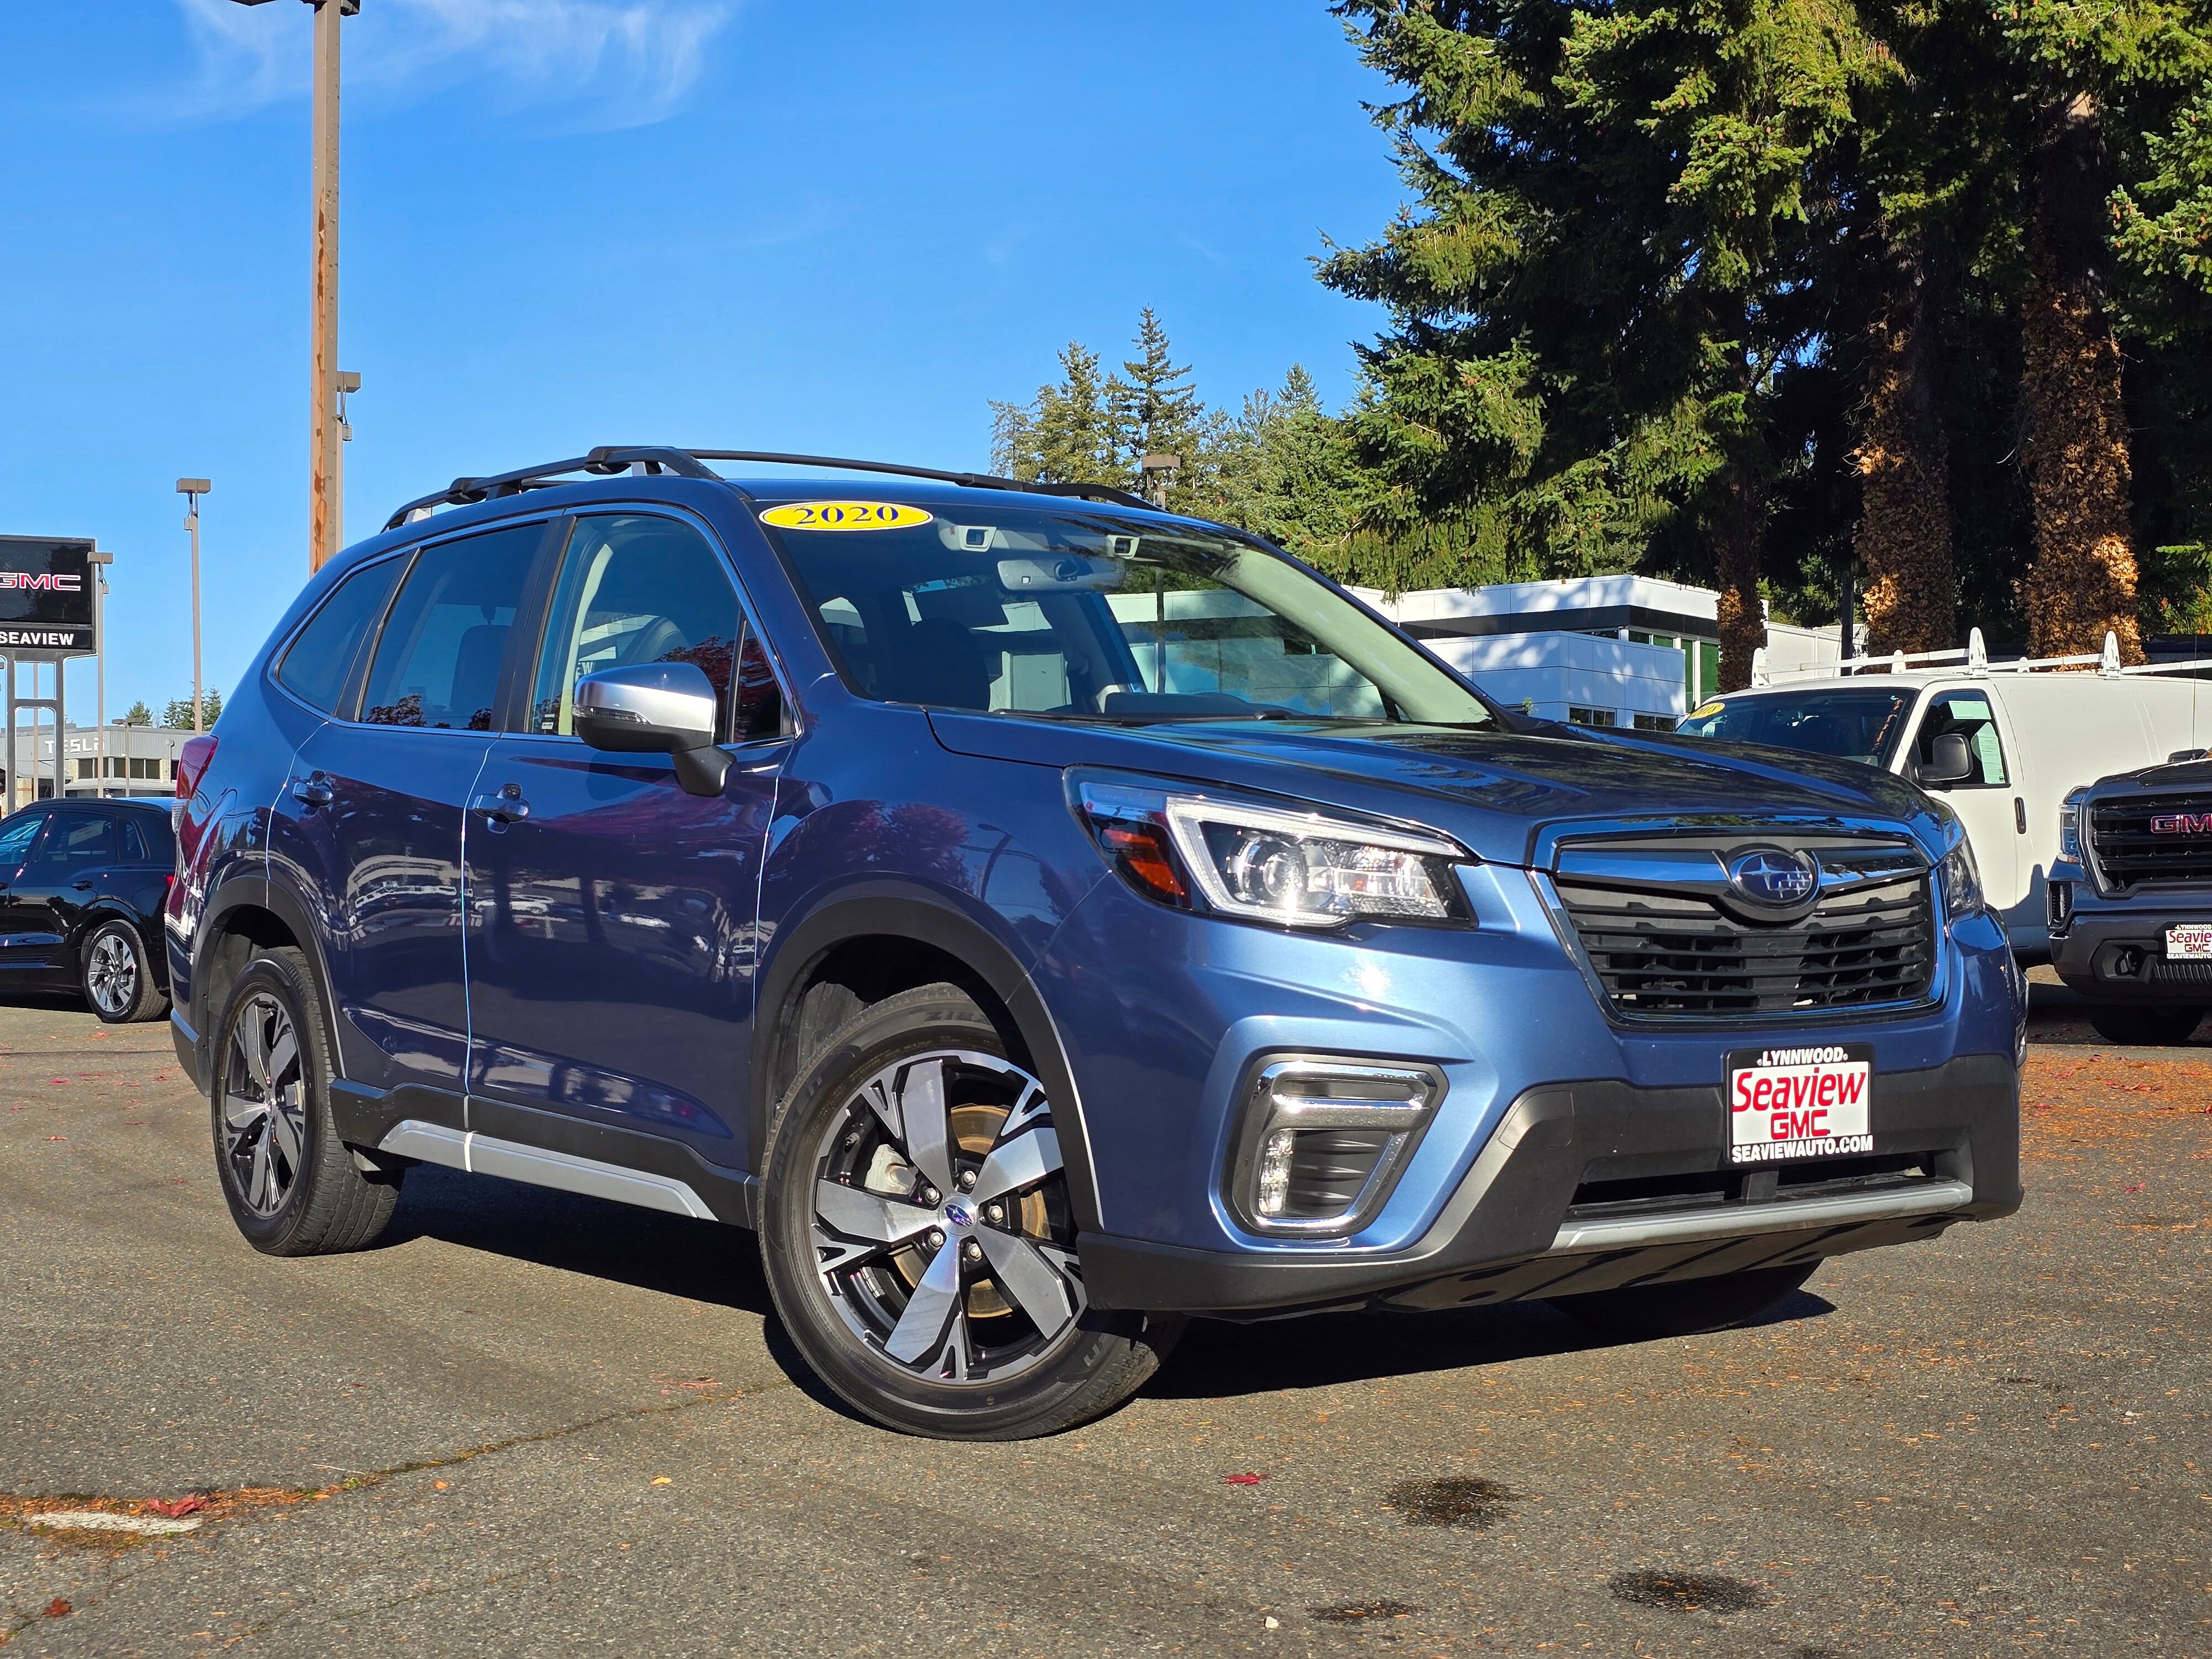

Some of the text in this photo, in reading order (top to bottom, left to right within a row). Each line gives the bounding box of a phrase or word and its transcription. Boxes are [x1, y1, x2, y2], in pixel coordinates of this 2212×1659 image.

[794, 505, 899, 525] 2020
[0, 572, 81, 591] GMC
[0, 631, 74, 645] SEAVIEW
[2151, 813, 2212, 834] GM
[2168, 930, 2212, 943] Seavie
[2184, 943, 2211, 952] GMC
[1762, 1047, 1844, 1067] LYNNWOOD
[1731, 1067, 1866, 1113] Seaview
[1771, 1109, 1829, 1140] GMC
[1731, 1135, 1874, 1164] SEAVIEWAUTO.COM
